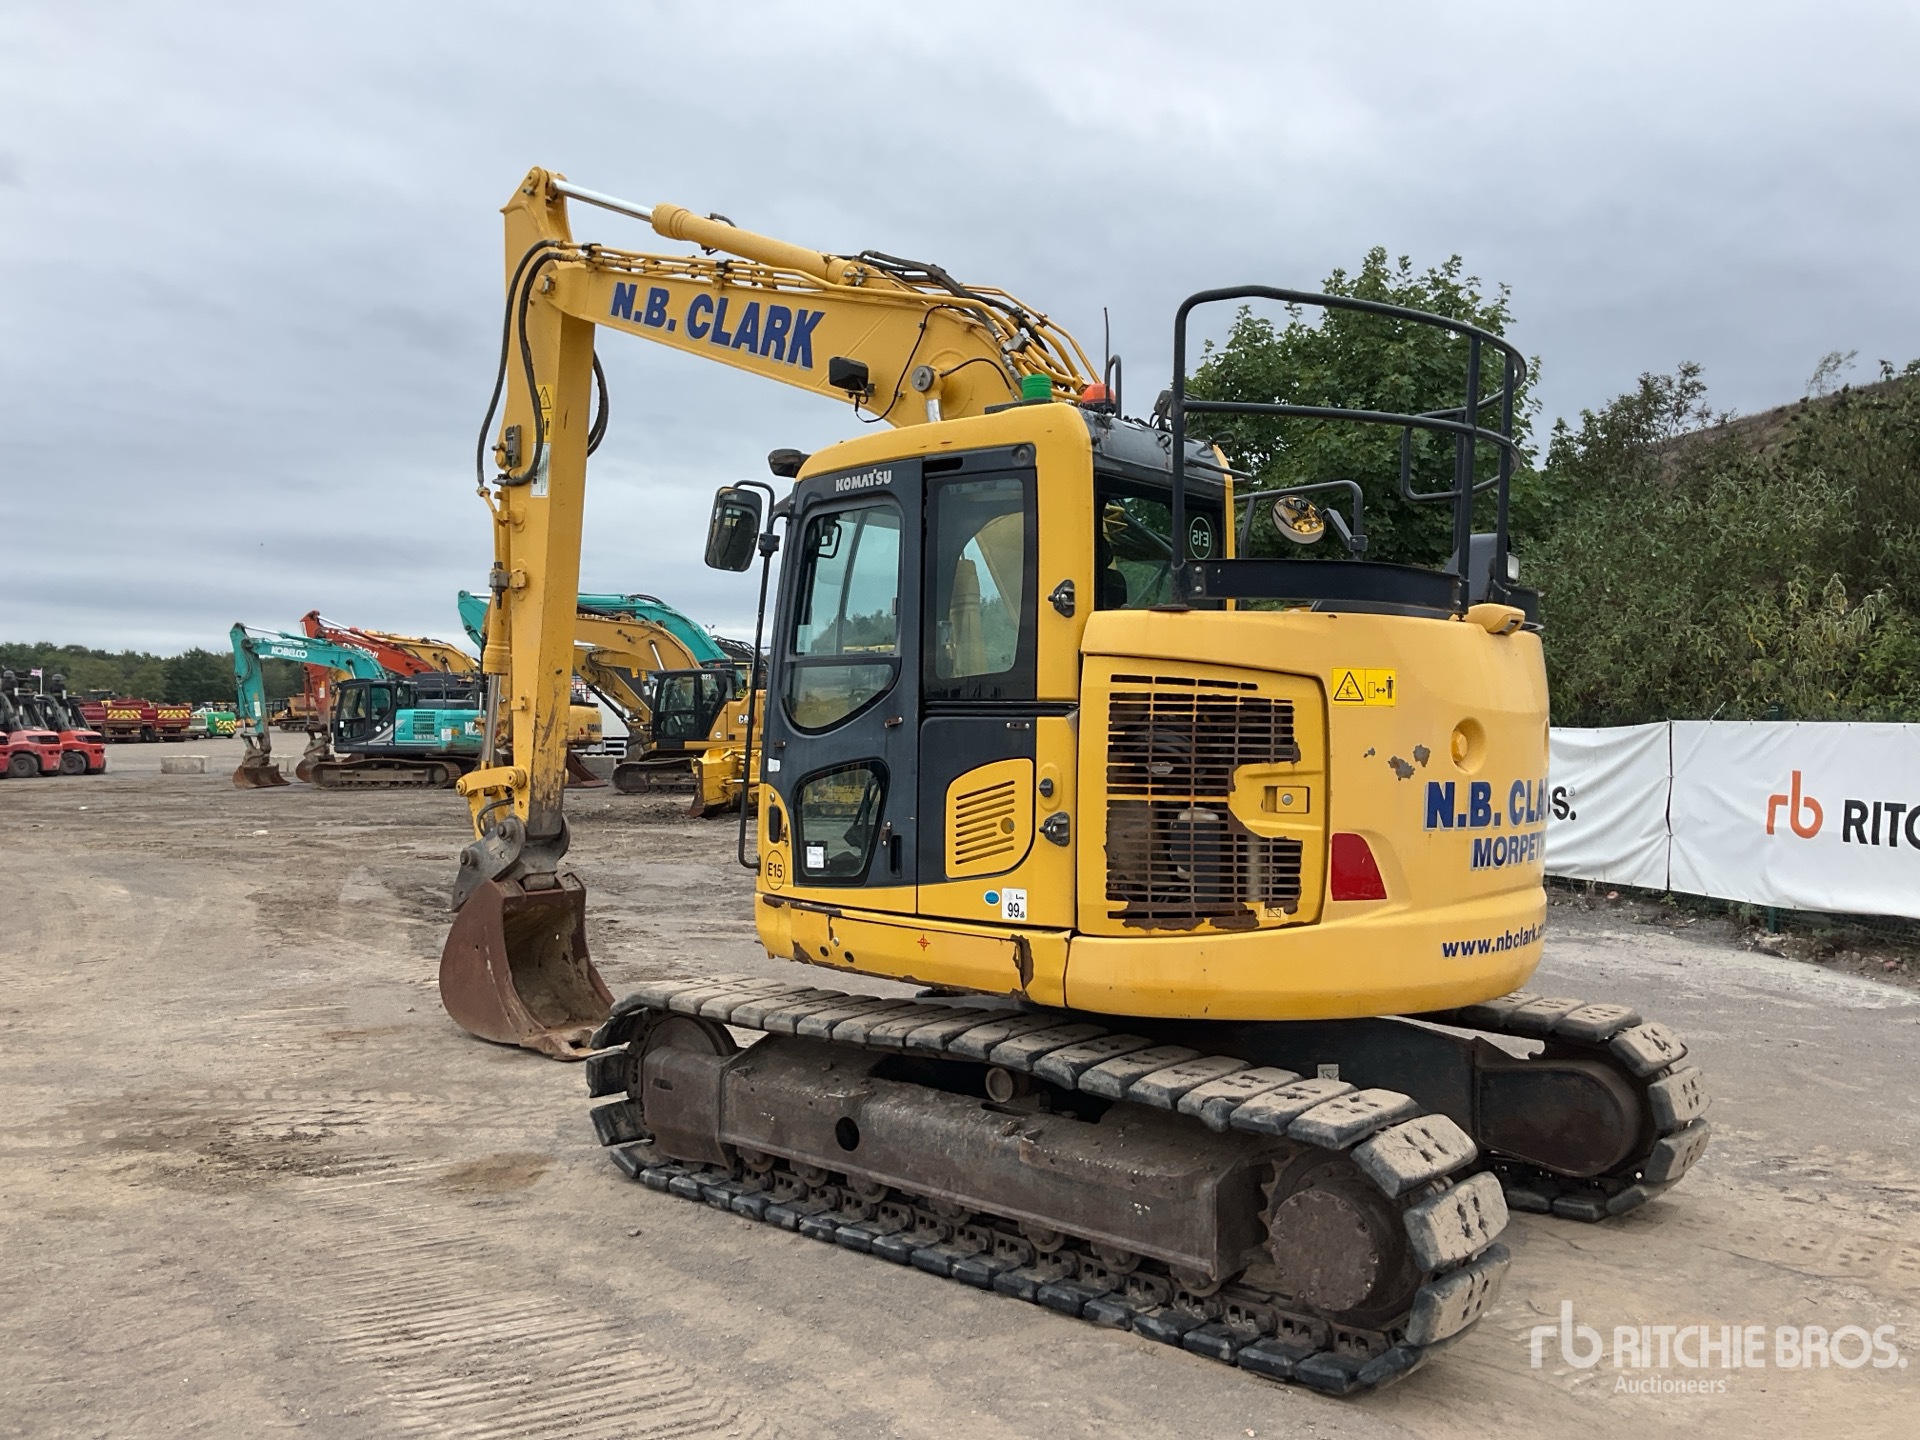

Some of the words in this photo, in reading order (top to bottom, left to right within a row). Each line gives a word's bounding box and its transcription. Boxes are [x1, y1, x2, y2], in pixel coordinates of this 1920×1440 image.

[610, 281, 677, 333] N.B.
[685, 293, 826, 369] CLARK
[835, 468, 892, 492] KOMATSU
[271, 645, 308, 659] KOBELCO
[738, 714, 749, 724] CA
[1424, 781, 1502, 831] N.B.
[1509, 778, 1548, 827] CLA
[1766, 770, 1824, 839] rb
[1470, 831, 1546, 870] MORPET
[767, 862, 783, 878] E15
[1007, 901, 1020, 918] 99
